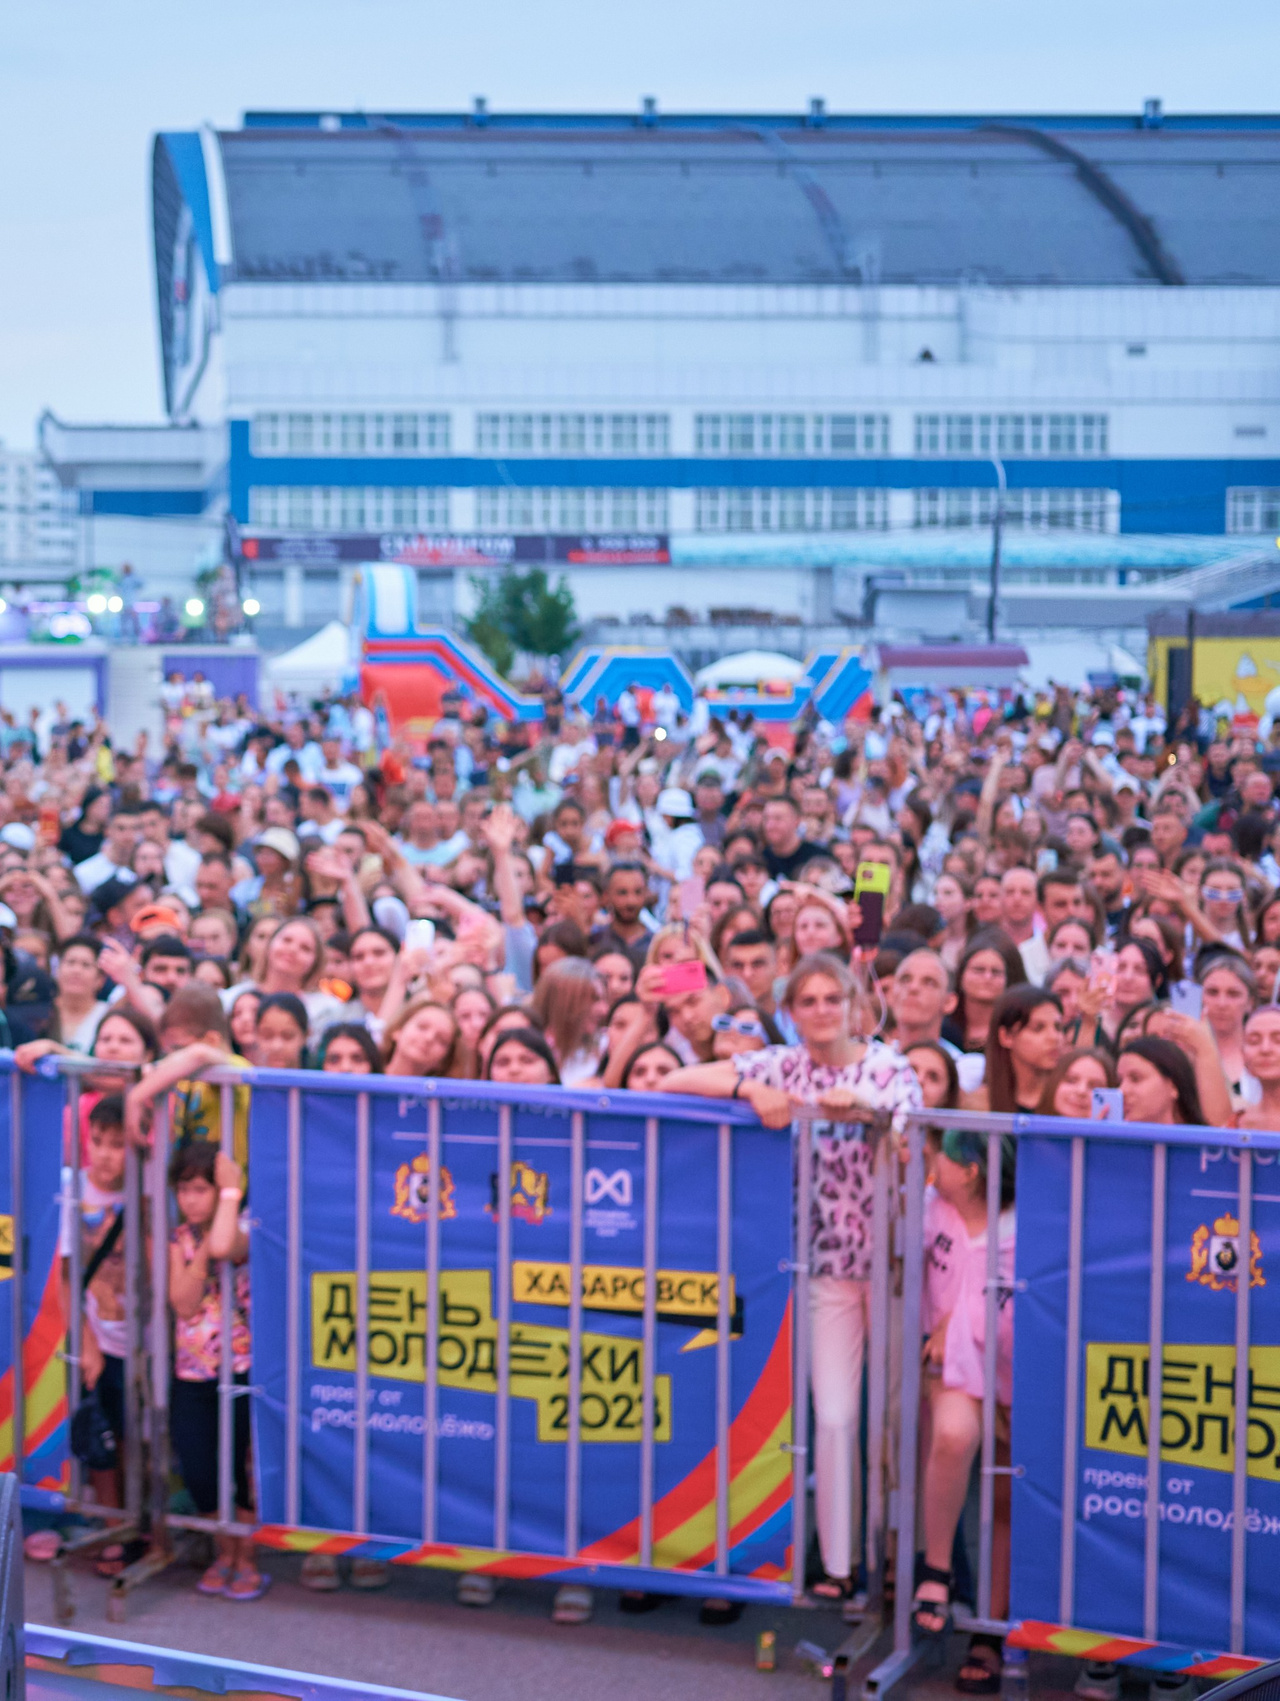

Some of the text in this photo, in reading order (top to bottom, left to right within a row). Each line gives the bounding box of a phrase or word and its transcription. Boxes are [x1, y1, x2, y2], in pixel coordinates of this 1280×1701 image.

[323, 1283, 481, 1327] ДЕНЬ
[1100, 1354, 1280, 1411] ДЕНЬ
[1100, 1404, 1280, 1470] МОЛО
[1083, 1467, 1195, 1495] проек от
